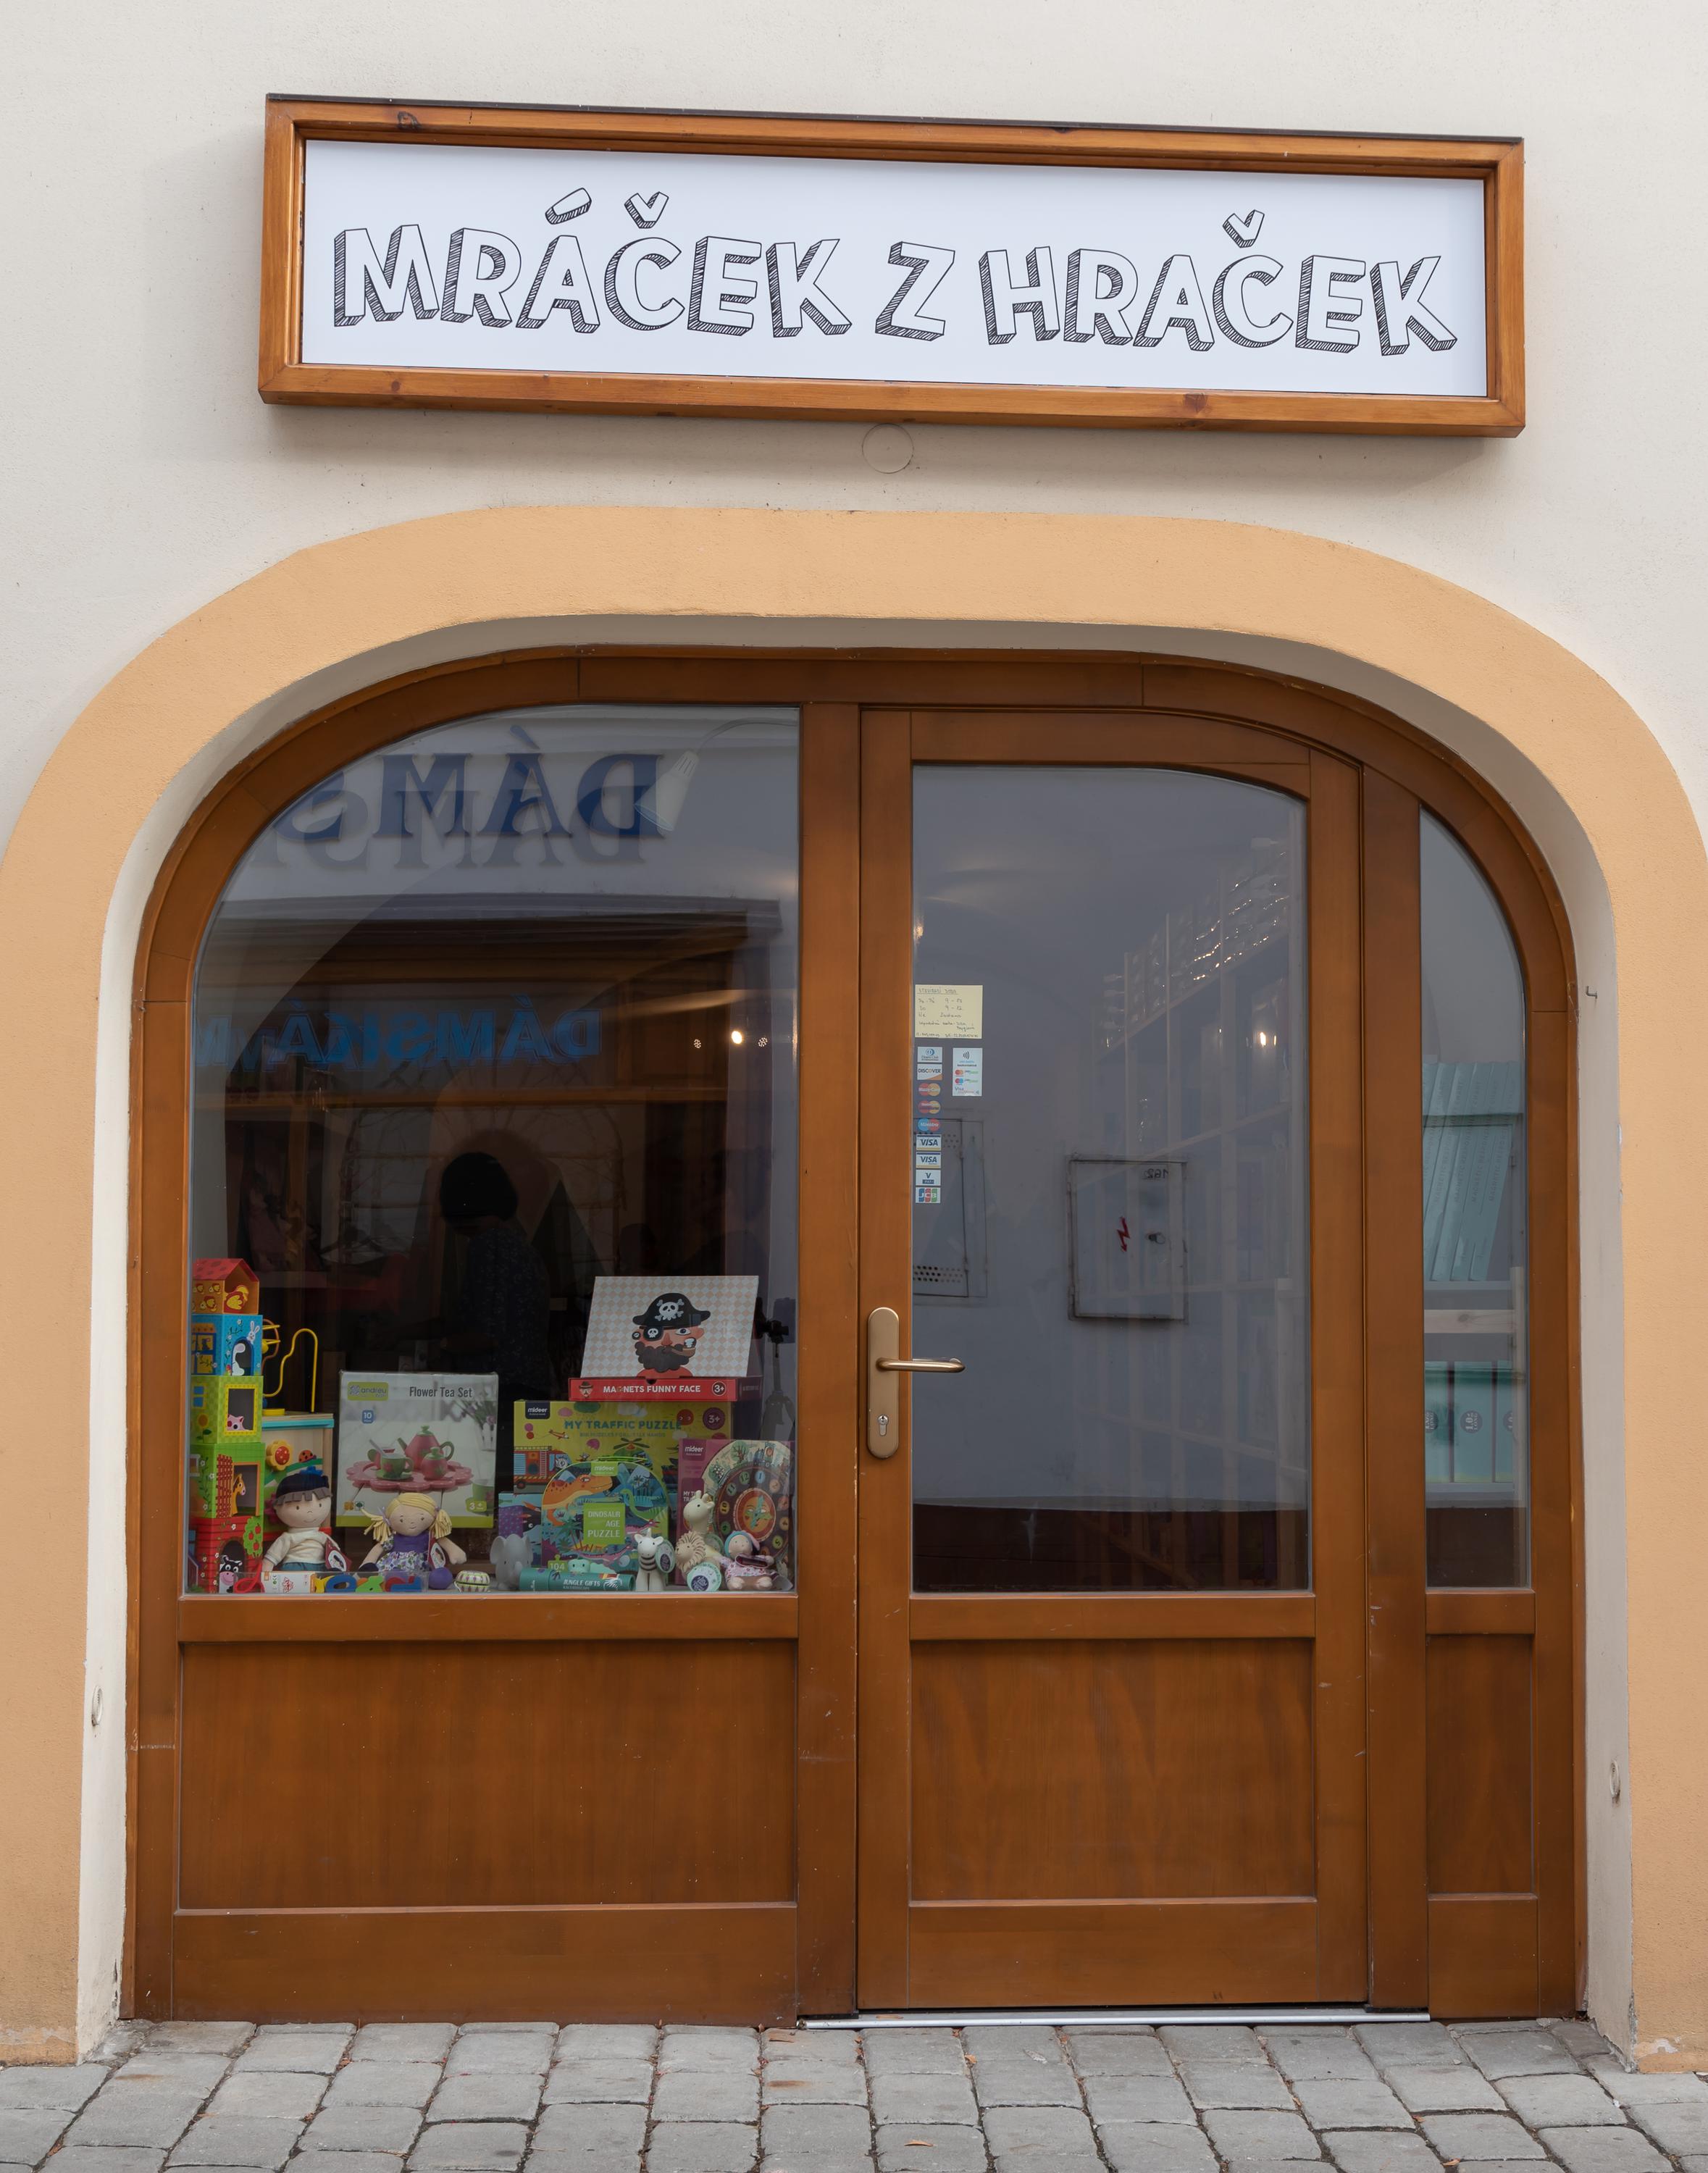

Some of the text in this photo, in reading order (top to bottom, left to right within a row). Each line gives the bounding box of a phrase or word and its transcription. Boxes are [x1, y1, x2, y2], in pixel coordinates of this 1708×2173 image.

[334, 187, 1458, 356] MRÁČEK Z HRAČEK
[409, 1386, 472, 1397] Flower Tea Set
[714, 1384, 725, 1393] 3+
[708, 1415, 720, 1423] 3+
[565, 1420, 682, 1430] MY TRAFFIC PUZZLE
[587, 1529, 621, 1538] PUZZLE
